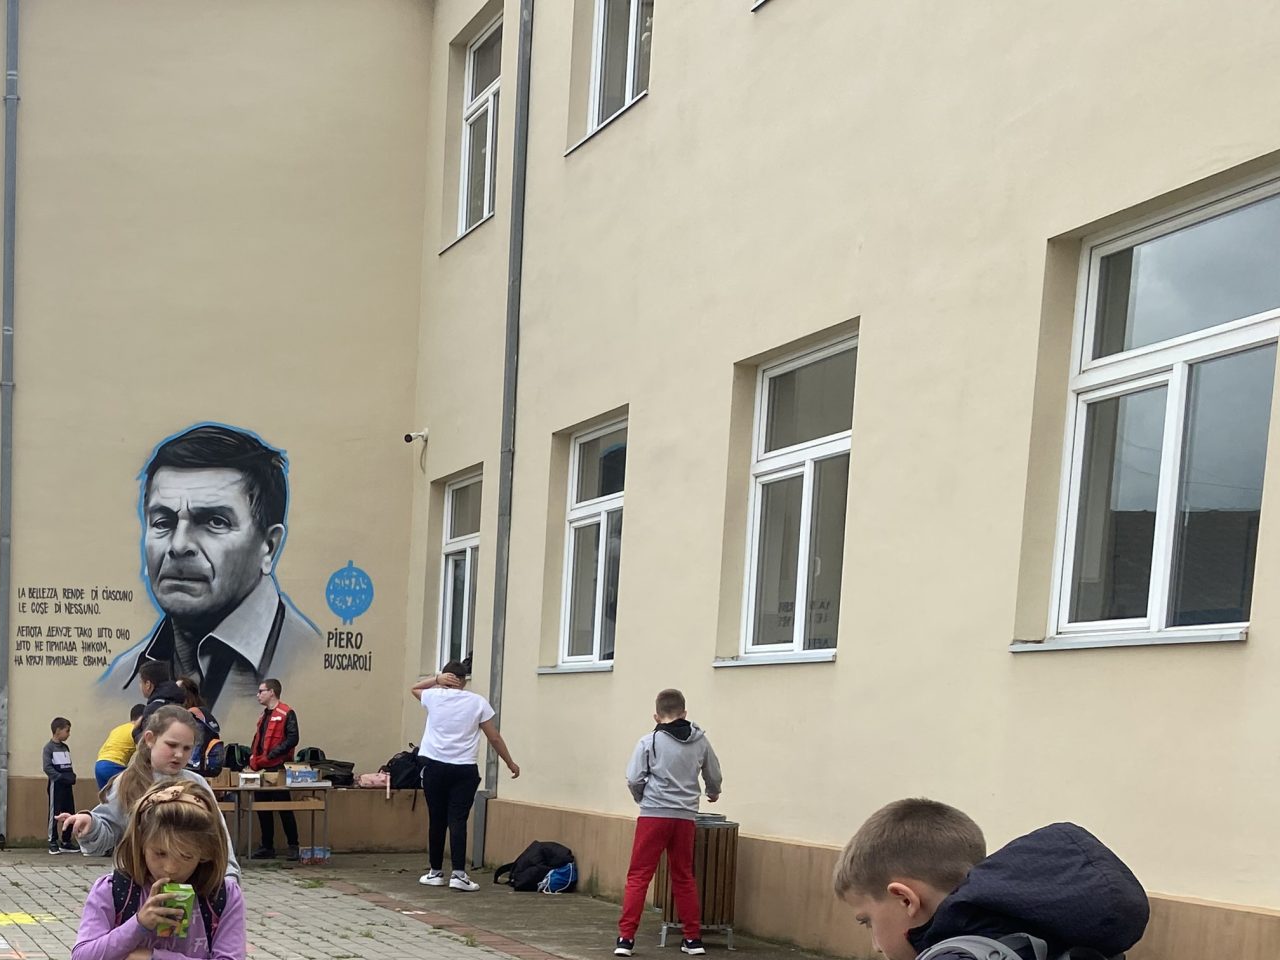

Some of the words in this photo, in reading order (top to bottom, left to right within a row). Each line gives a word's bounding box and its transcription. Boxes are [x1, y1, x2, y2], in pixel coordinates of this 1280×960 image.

[18, 587, 25, 598] LA
[28, 587, 58, 600] BELLEZZA
[62, 588, 85, 600] RENDE
[18, 602, 27, 613] LE
[31, 602, 49, 614] COSE
[64, 603, 101, 615] NESSUNO.
[17, 625, 43, 638] ЛЕПОТА
[97, 627, 113, 639] ШТО
